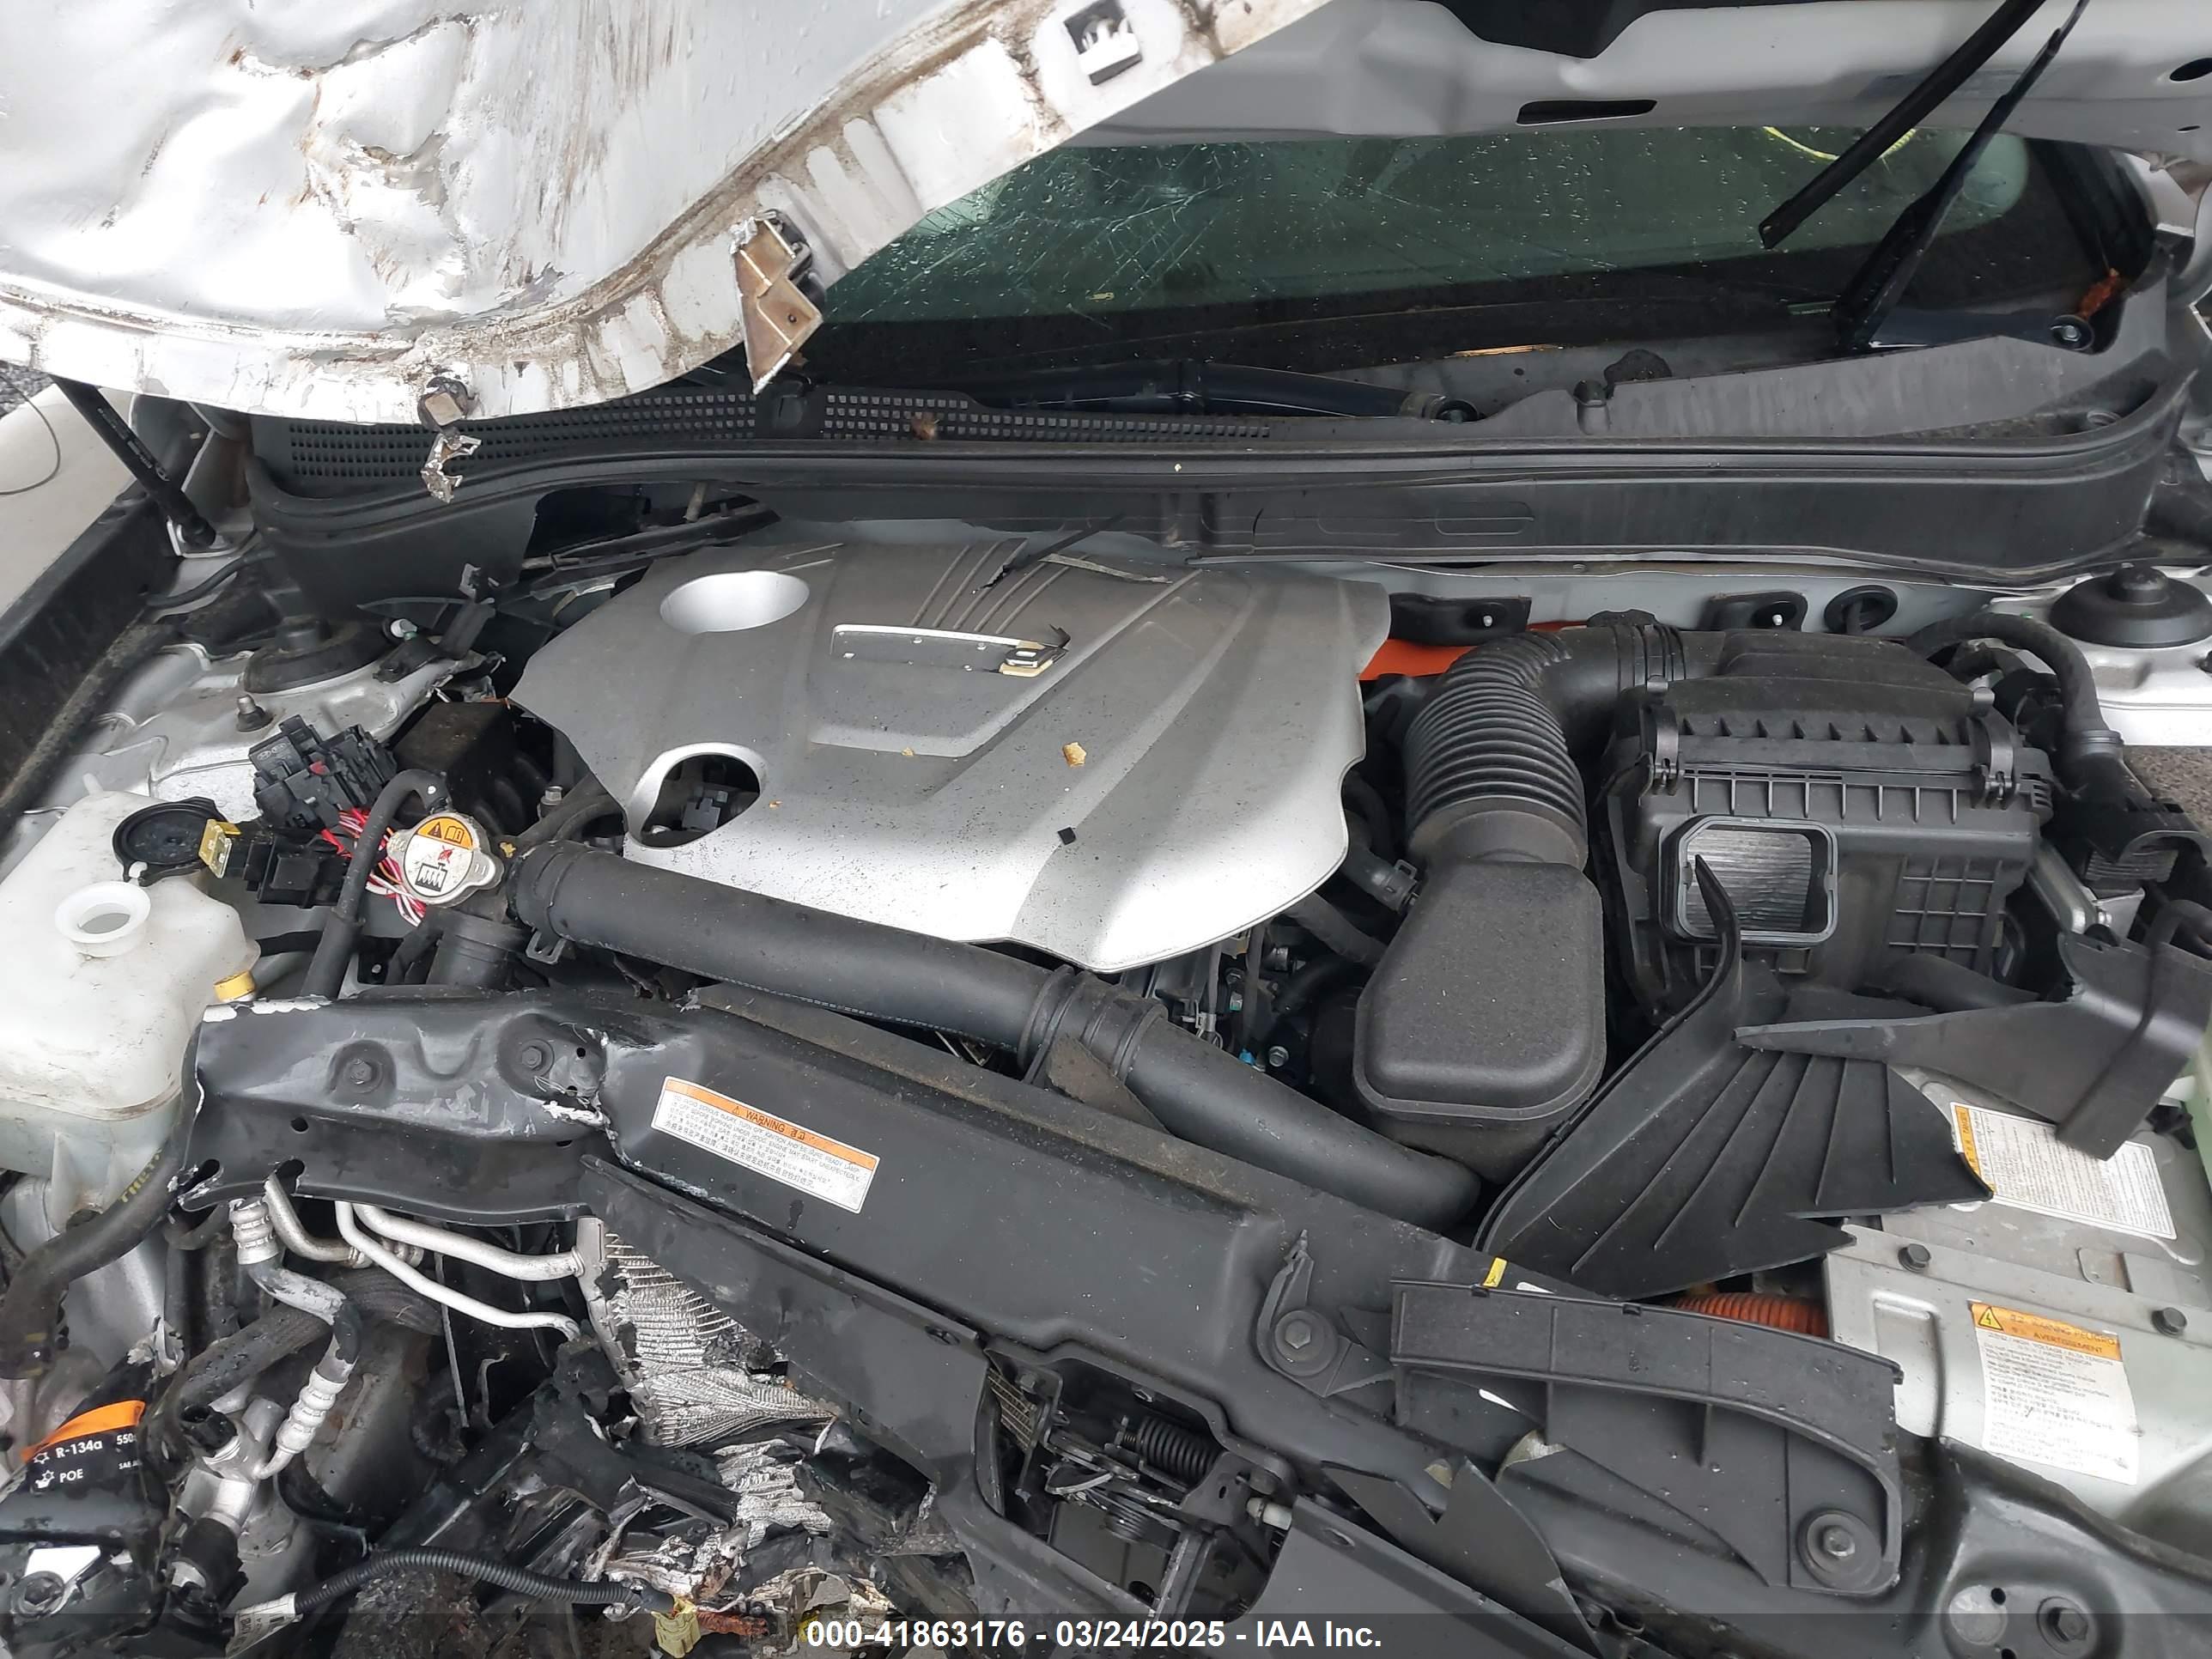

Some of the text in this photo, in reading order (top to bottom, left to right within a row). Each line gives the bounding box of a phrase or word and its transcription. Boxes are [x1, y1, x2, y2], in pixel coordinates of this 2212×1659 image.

[744, 1109, 786, 1133] WARNING
[56, 1440, 103, 1458] R-134a
[59, 1468, 84, 1483] POE
